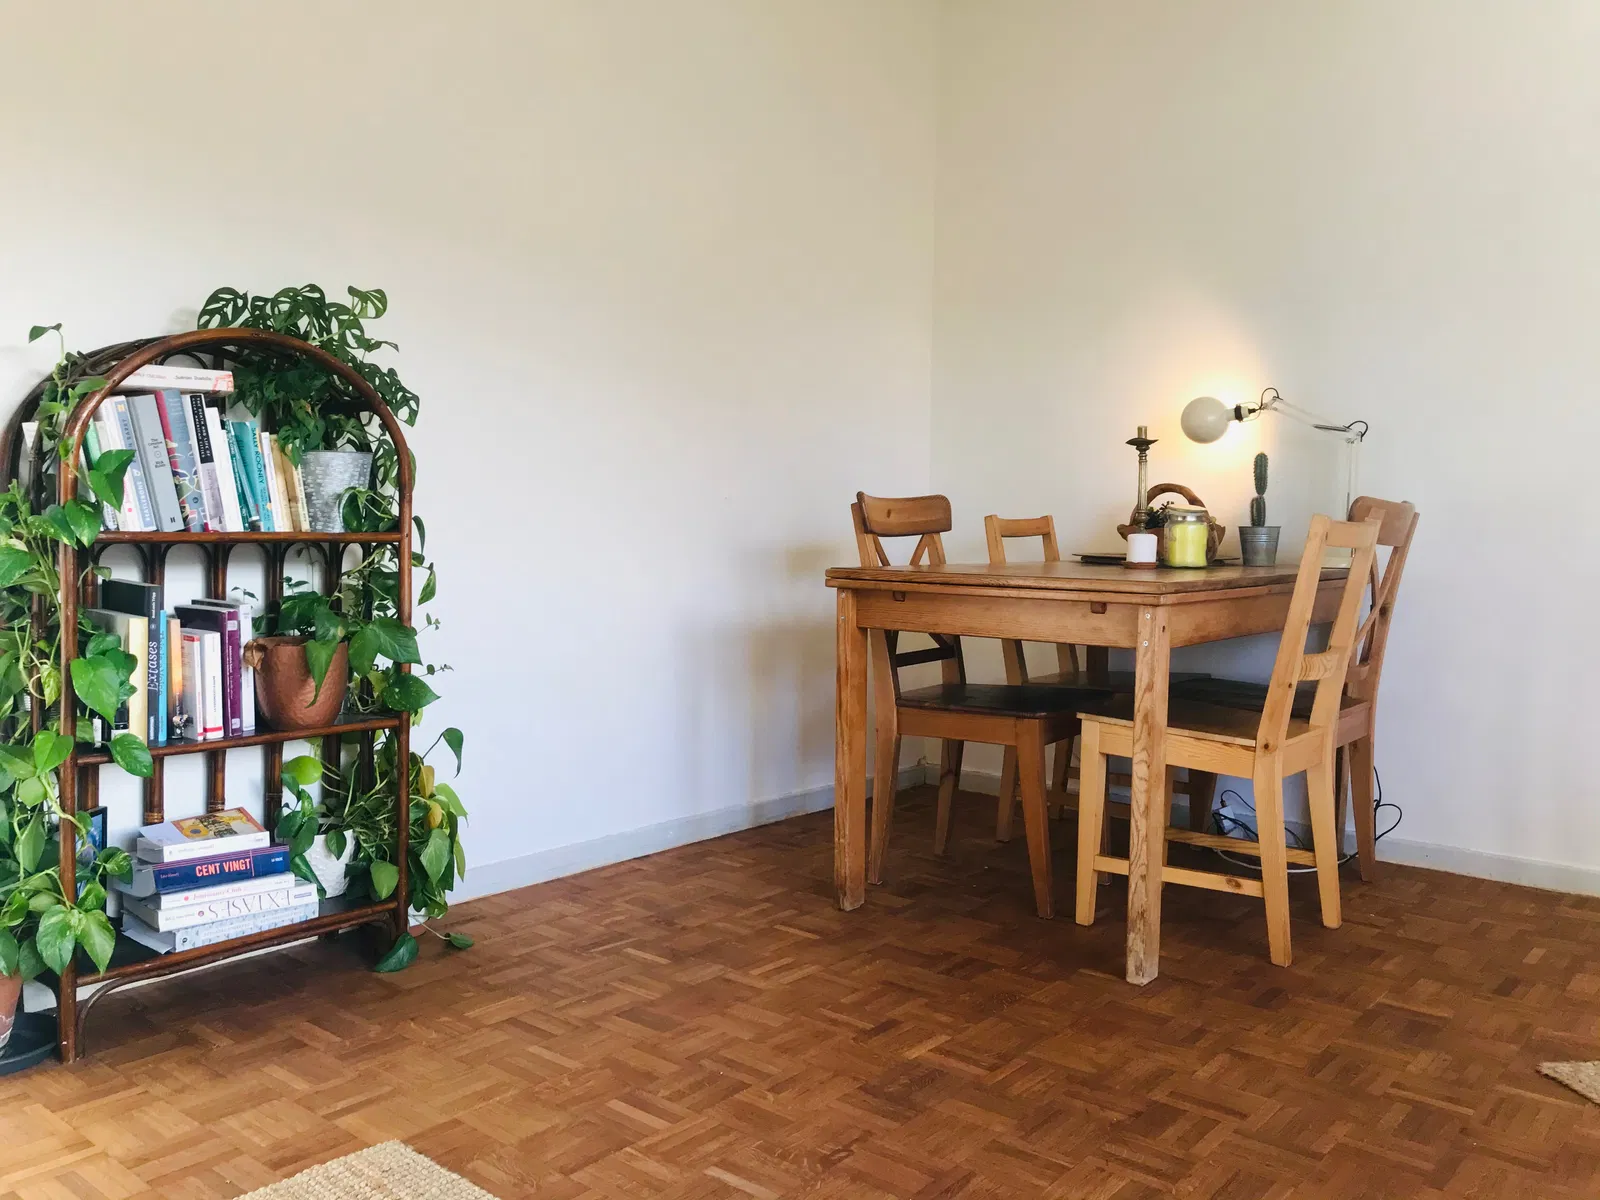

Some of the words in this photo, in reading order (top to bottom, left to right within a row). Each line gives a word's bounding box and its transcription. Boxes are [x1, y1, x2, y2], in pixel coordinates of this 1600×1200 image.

[251, 427, 259, 449] SALLY
[255, 450, 265, 485] ROONEY
[147, 641, 159, 691] Extases
[195, 863, 220, 878] CENT
[222, 858, 251, 873] VINGT
